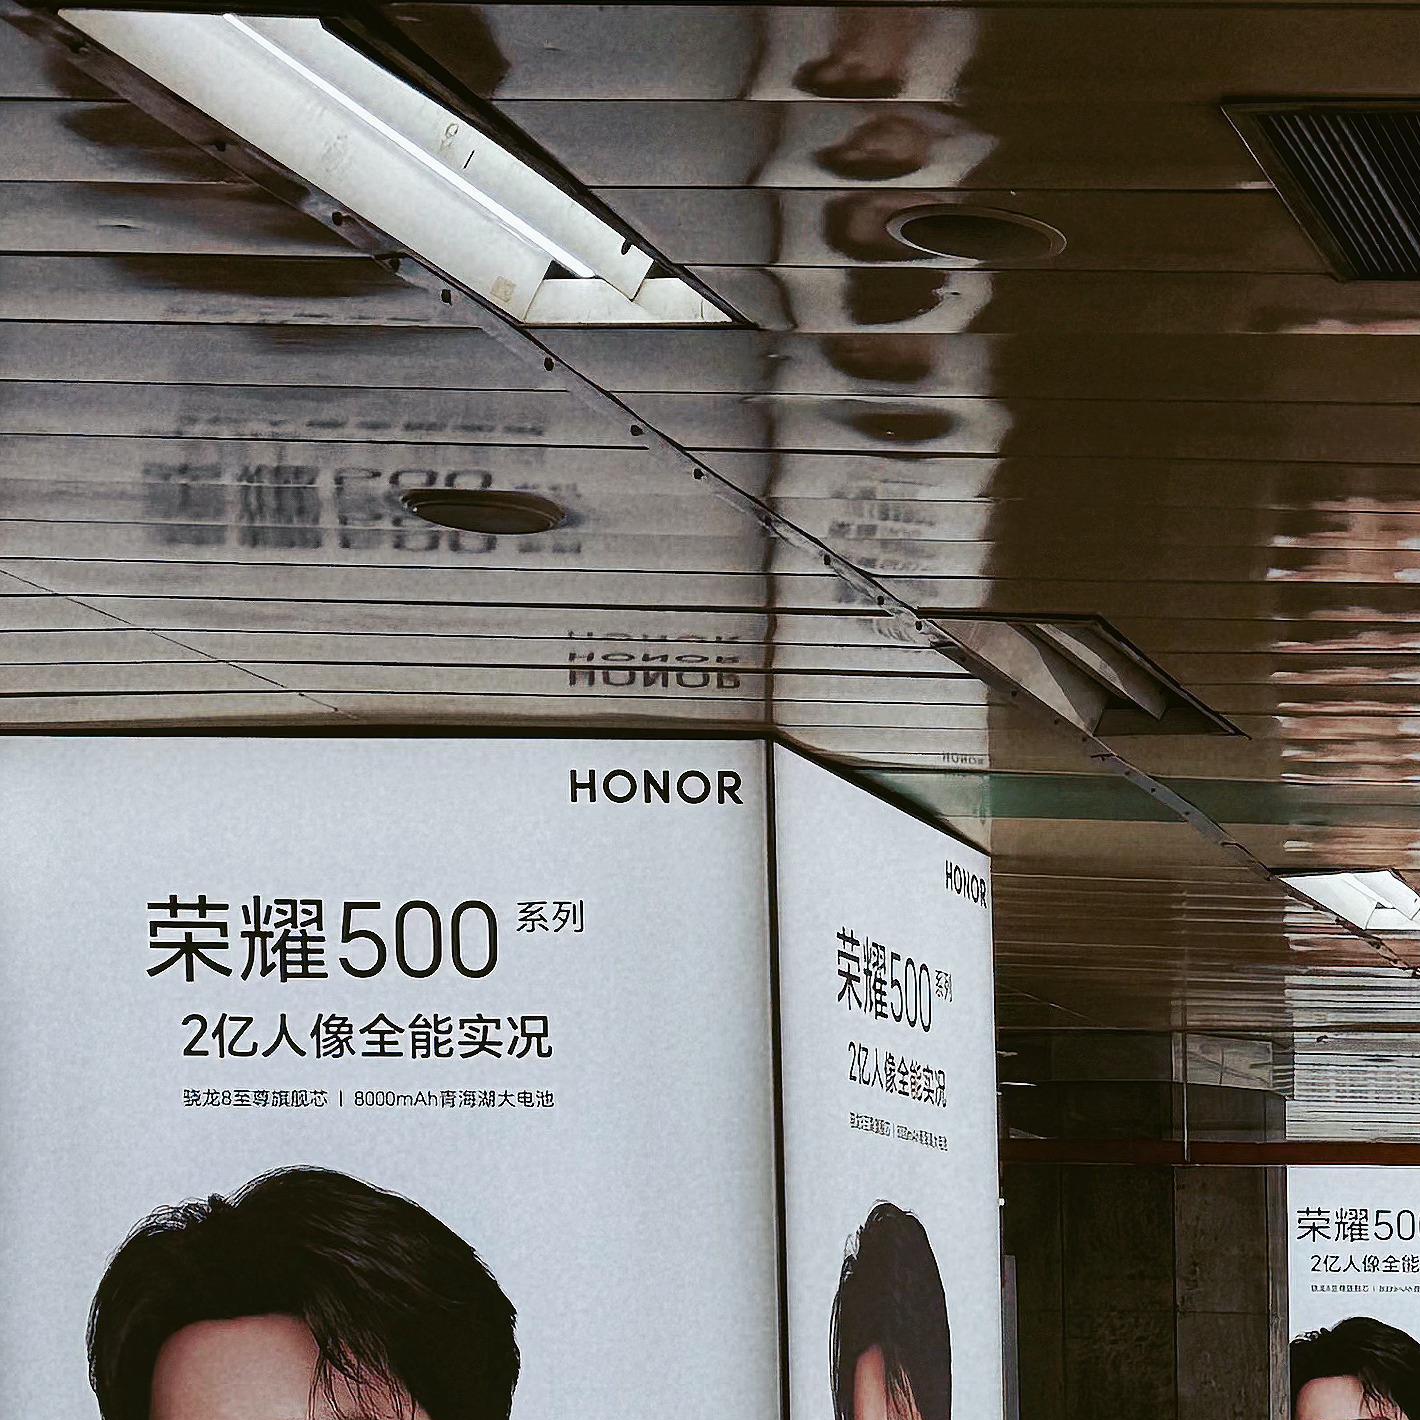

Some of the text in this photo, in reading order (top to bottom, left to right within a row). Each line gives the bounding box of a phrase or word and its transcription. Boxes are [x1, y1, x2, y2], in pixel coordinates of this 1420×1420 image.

[569, 769, 743, 804] HONOR
[146, 894, 584, 983] 荣耀500 系列
[836, 926, 931, 1032] 荣耀500
[181, 1013, 553, 1060] 2亿人像全能实况
[849, 1041, 947, 1108] 2亿人像全能实况
